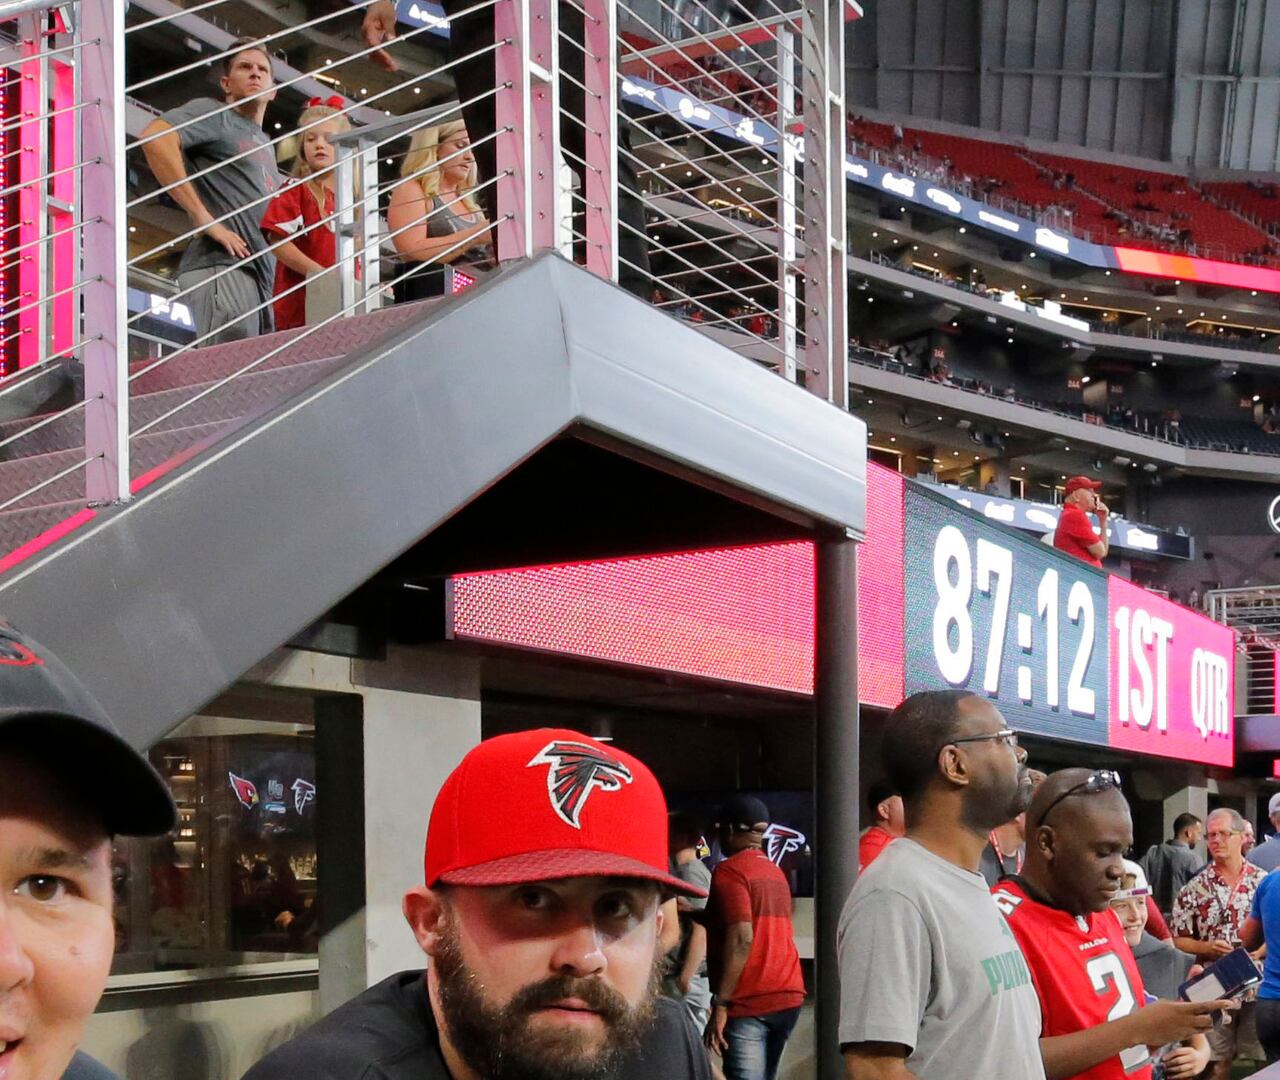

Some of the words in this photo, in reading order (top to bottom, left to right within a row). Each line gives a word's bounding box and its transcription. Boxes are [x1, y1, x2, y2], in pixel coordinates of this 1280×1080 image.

[933, 524, 1096, 715] 87:12
[1115, 606, 1174, 731] 1ST
[1190, 647, 1229, 738] QTR
[1086, 951, 1153, 1076] 2
